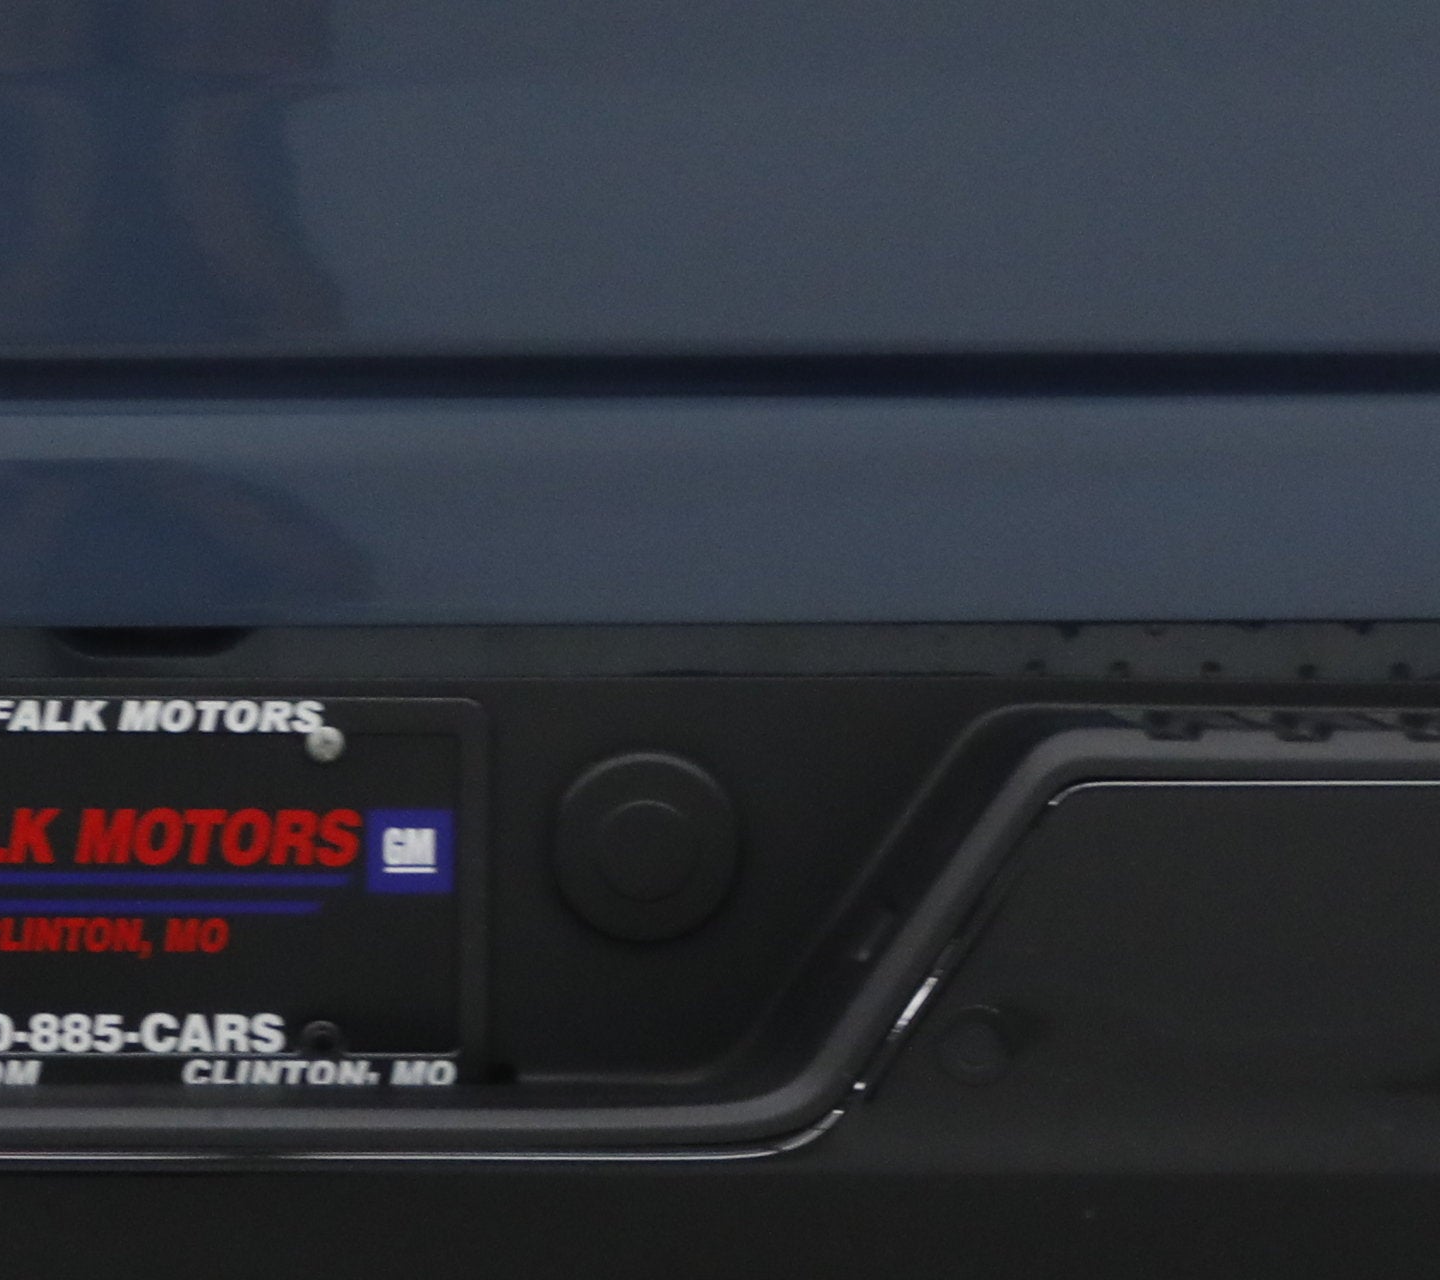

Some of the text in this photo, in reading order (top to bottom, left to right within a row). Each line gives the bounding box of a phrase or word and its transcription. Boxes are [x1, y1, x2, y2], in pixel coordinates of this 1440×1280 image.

[117, 699, 326, 734] MOTORS
[75, 808, 363, 867] MOTORS
[382, 827, 437, 866] GM
[164, 918, 229, 954] MO
[390, 1060, 458, 1087] MO
